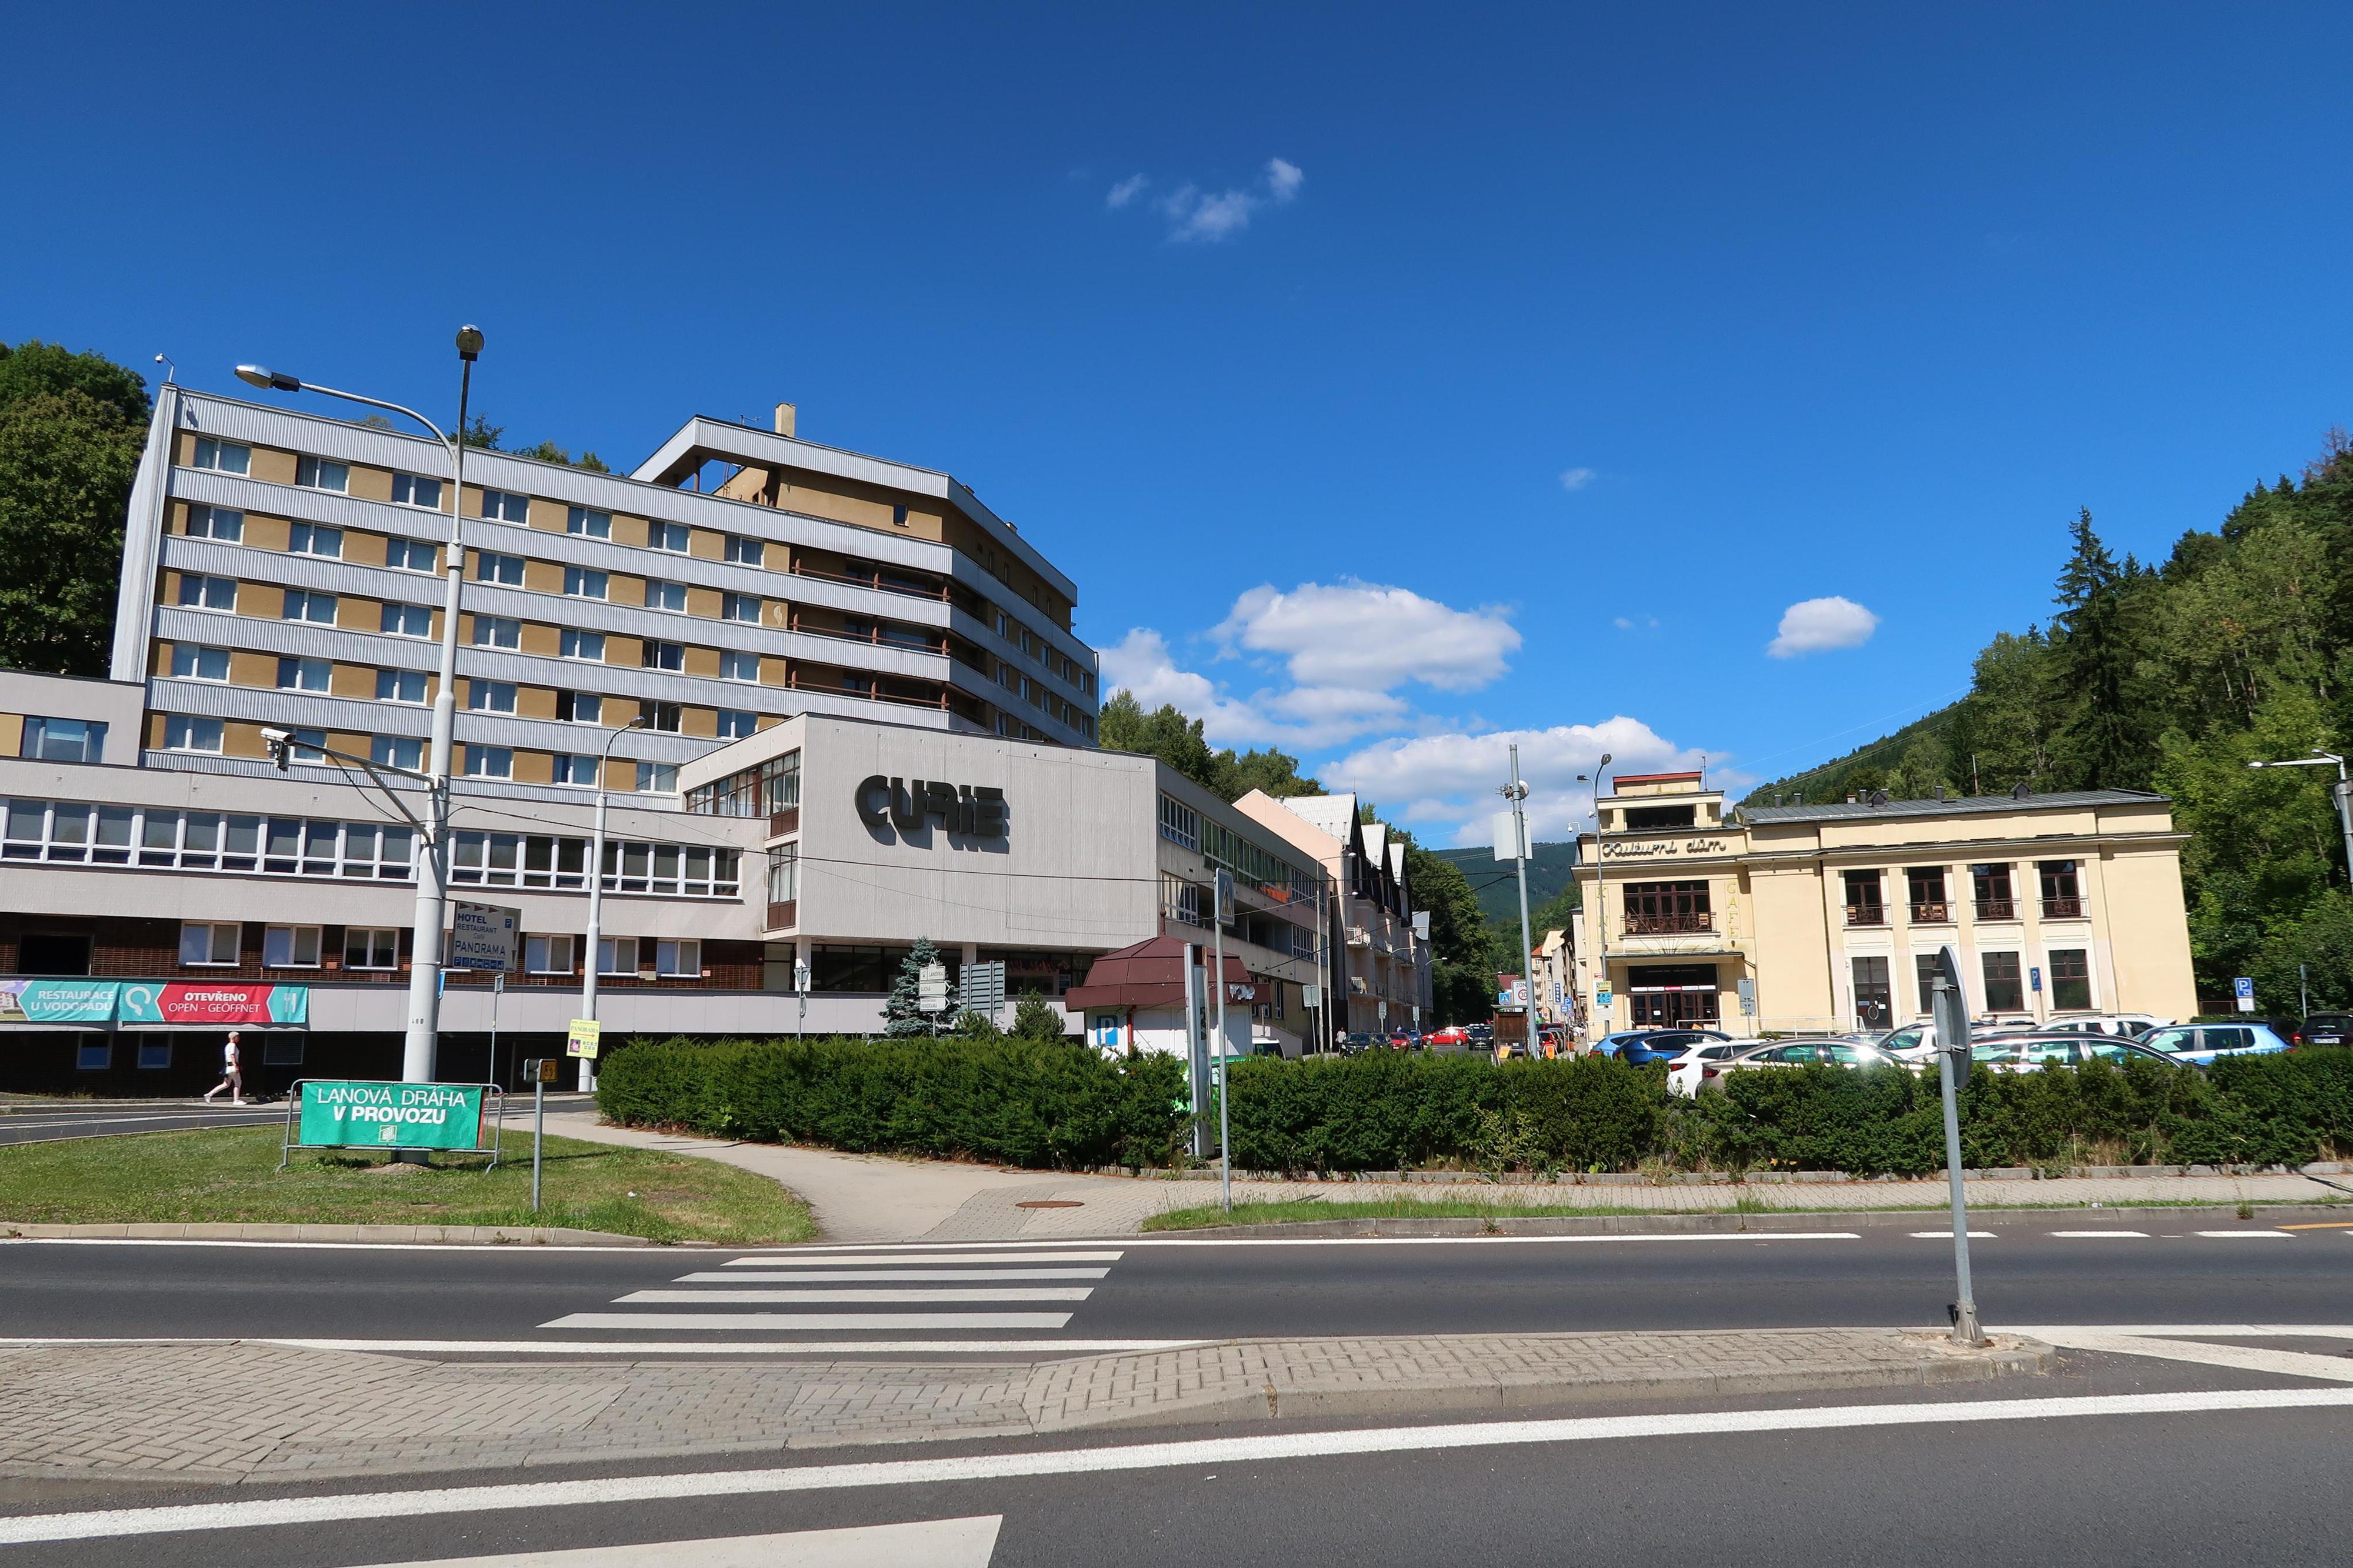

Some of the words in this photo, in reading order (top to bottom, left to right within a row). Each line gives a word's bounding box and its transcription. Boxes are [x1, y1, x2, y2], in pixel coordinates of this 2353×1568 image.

[855, 775, 1003, 836] CURIE
[1687, 838, 1727, 853] dům
[458, 913, 487, 924] HOTEL
[457, 923, 497, 933] RESTAURANT
[455, 940, 506, 956] PANORAMA
[2032, 970, 2038, 985] P
[2239, 980, 2248, 991] P
[38, 990, 115, 1000] RESTAURACE
[184, 990, 247, 1002] OTEVŘENO
[31, 1002, 39, 1011] U
[45, 1000, 113, 1011] VODOPÁDU
[168, 1003, 198, 1013] OPEN
[208, 1002, 261, 1013] GEÖFFNET
[1101, 1017, 1115, 1045] P
[318, 1087, 393, 1105] LANOVÁ
[401, 1089, 466, 1107] DRÁHA
[333, 1106, 347, 1121] V
[351, 1106, 446, 1124] PROVOZU
